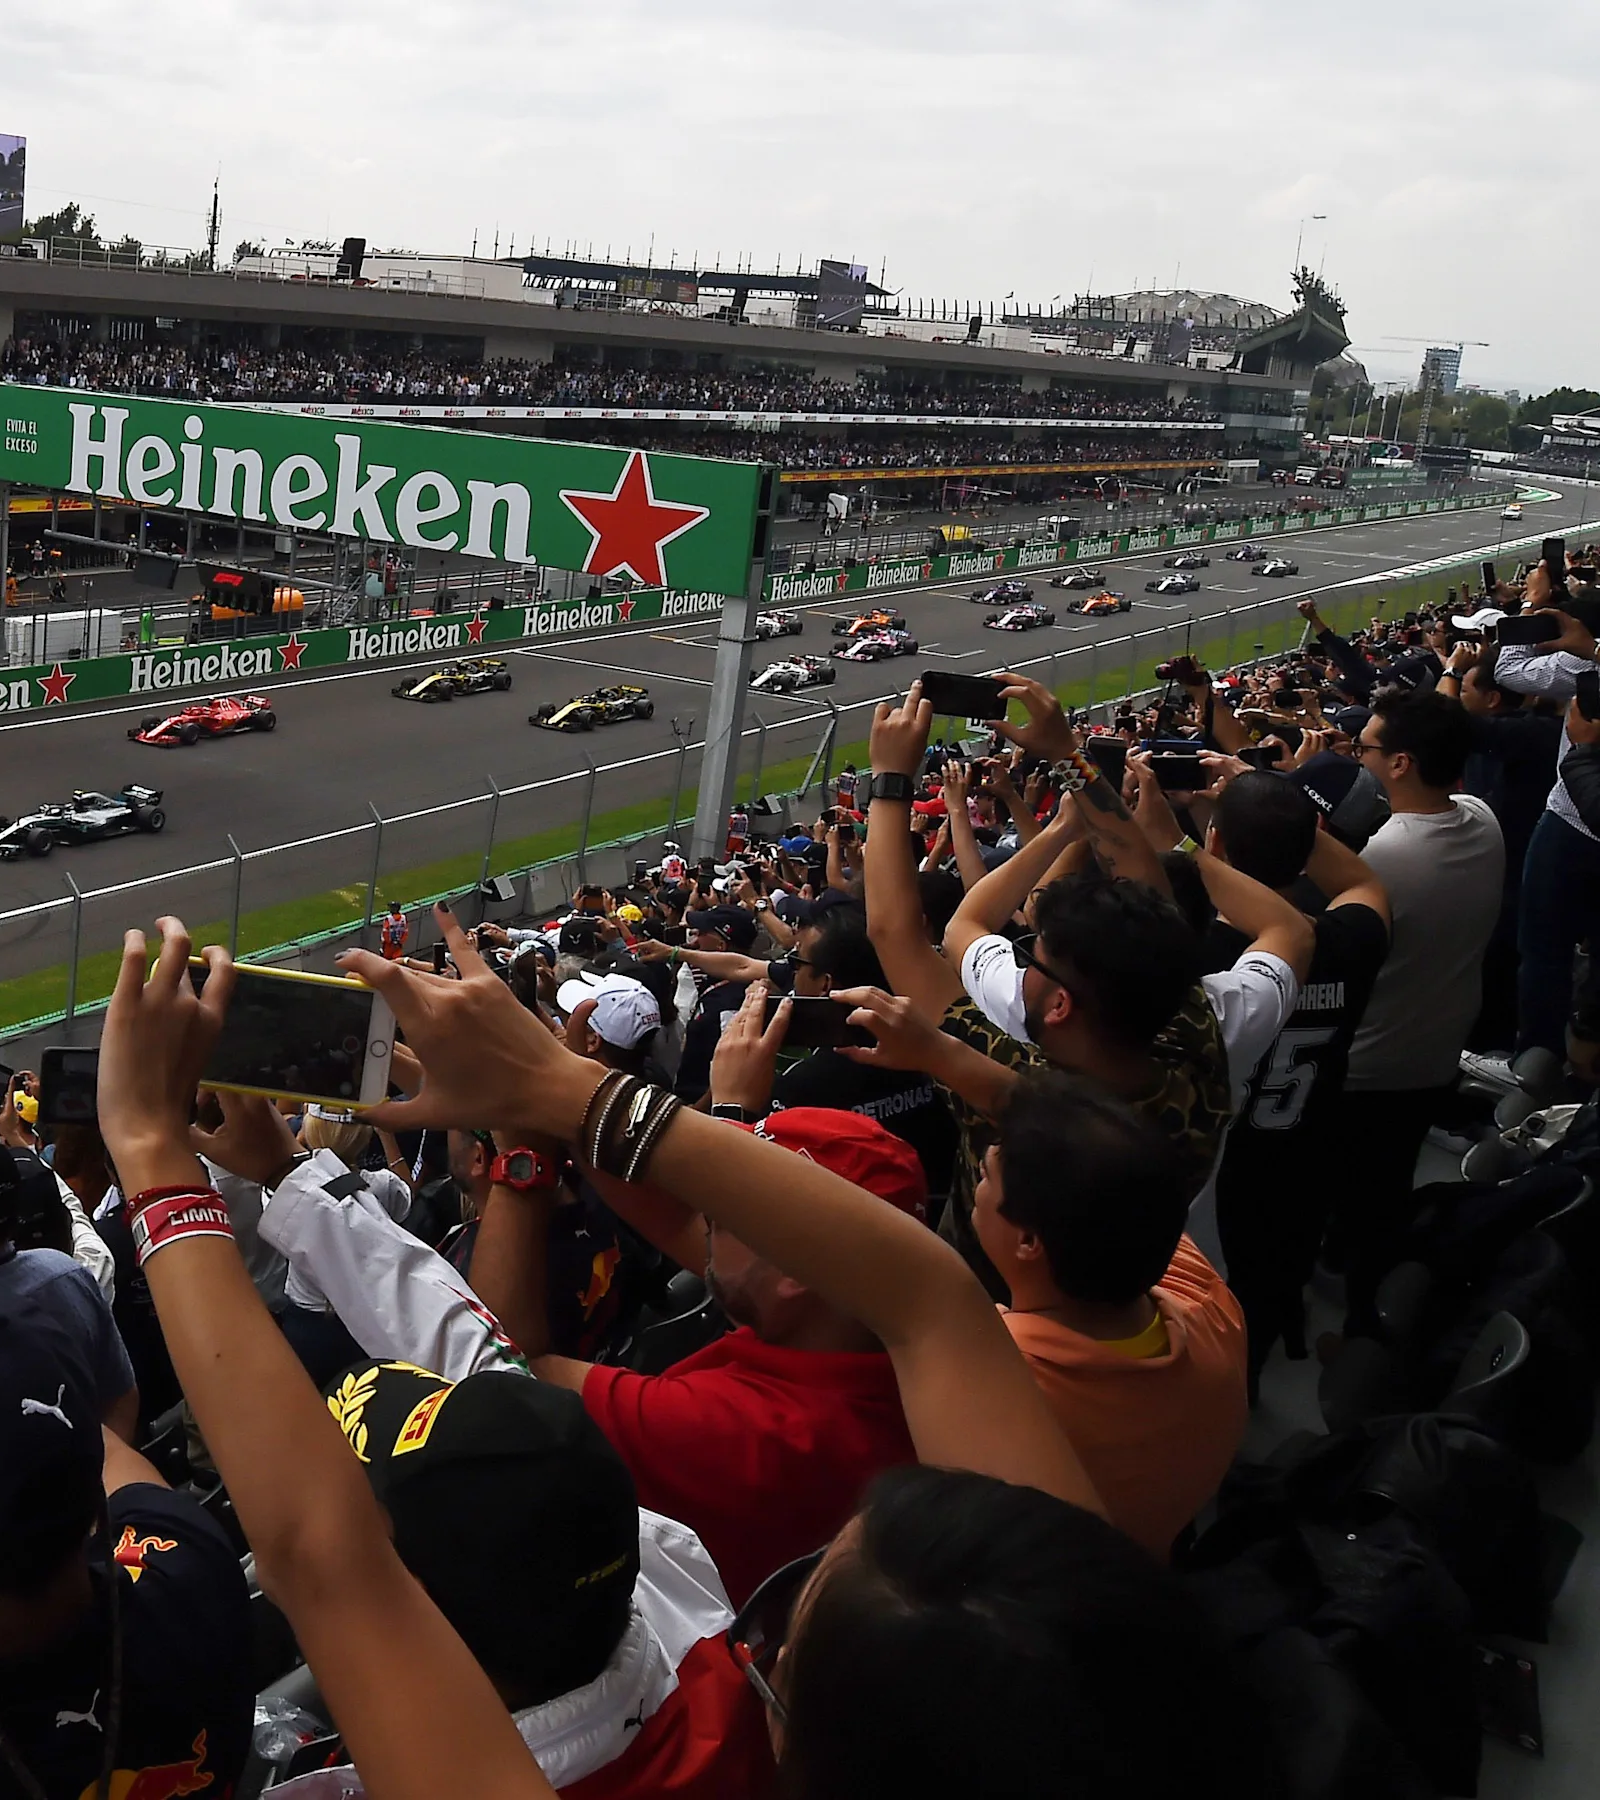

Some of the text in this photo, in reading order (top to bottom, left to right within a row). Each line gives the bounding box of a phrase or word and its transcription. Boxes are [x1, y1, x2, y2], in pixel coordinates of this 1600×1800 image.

[6, 419, 37, 435] EVITA EL
[5, 437, 38, 454] EXCESO
[65, 402, 536, 565] Heineken
[1128, 535, 1159, 551] Heineken
[1174, 527, 1203, 545] Heineken
[1018, 546, 1056, 567] Heineken
[1077, 540, 1111, 558] Heineken
[866, 561, 919, 588] Heineken
[948, 554, 994, 576] Heineken
[771, 574, 833, 601] Heineken
[522, 602, 612, 637] Heineken
[347, 620, 460, 661] Heineken
[129, 642, 272, 692] Heineken
[1308, 789, 1334, 812] exact
